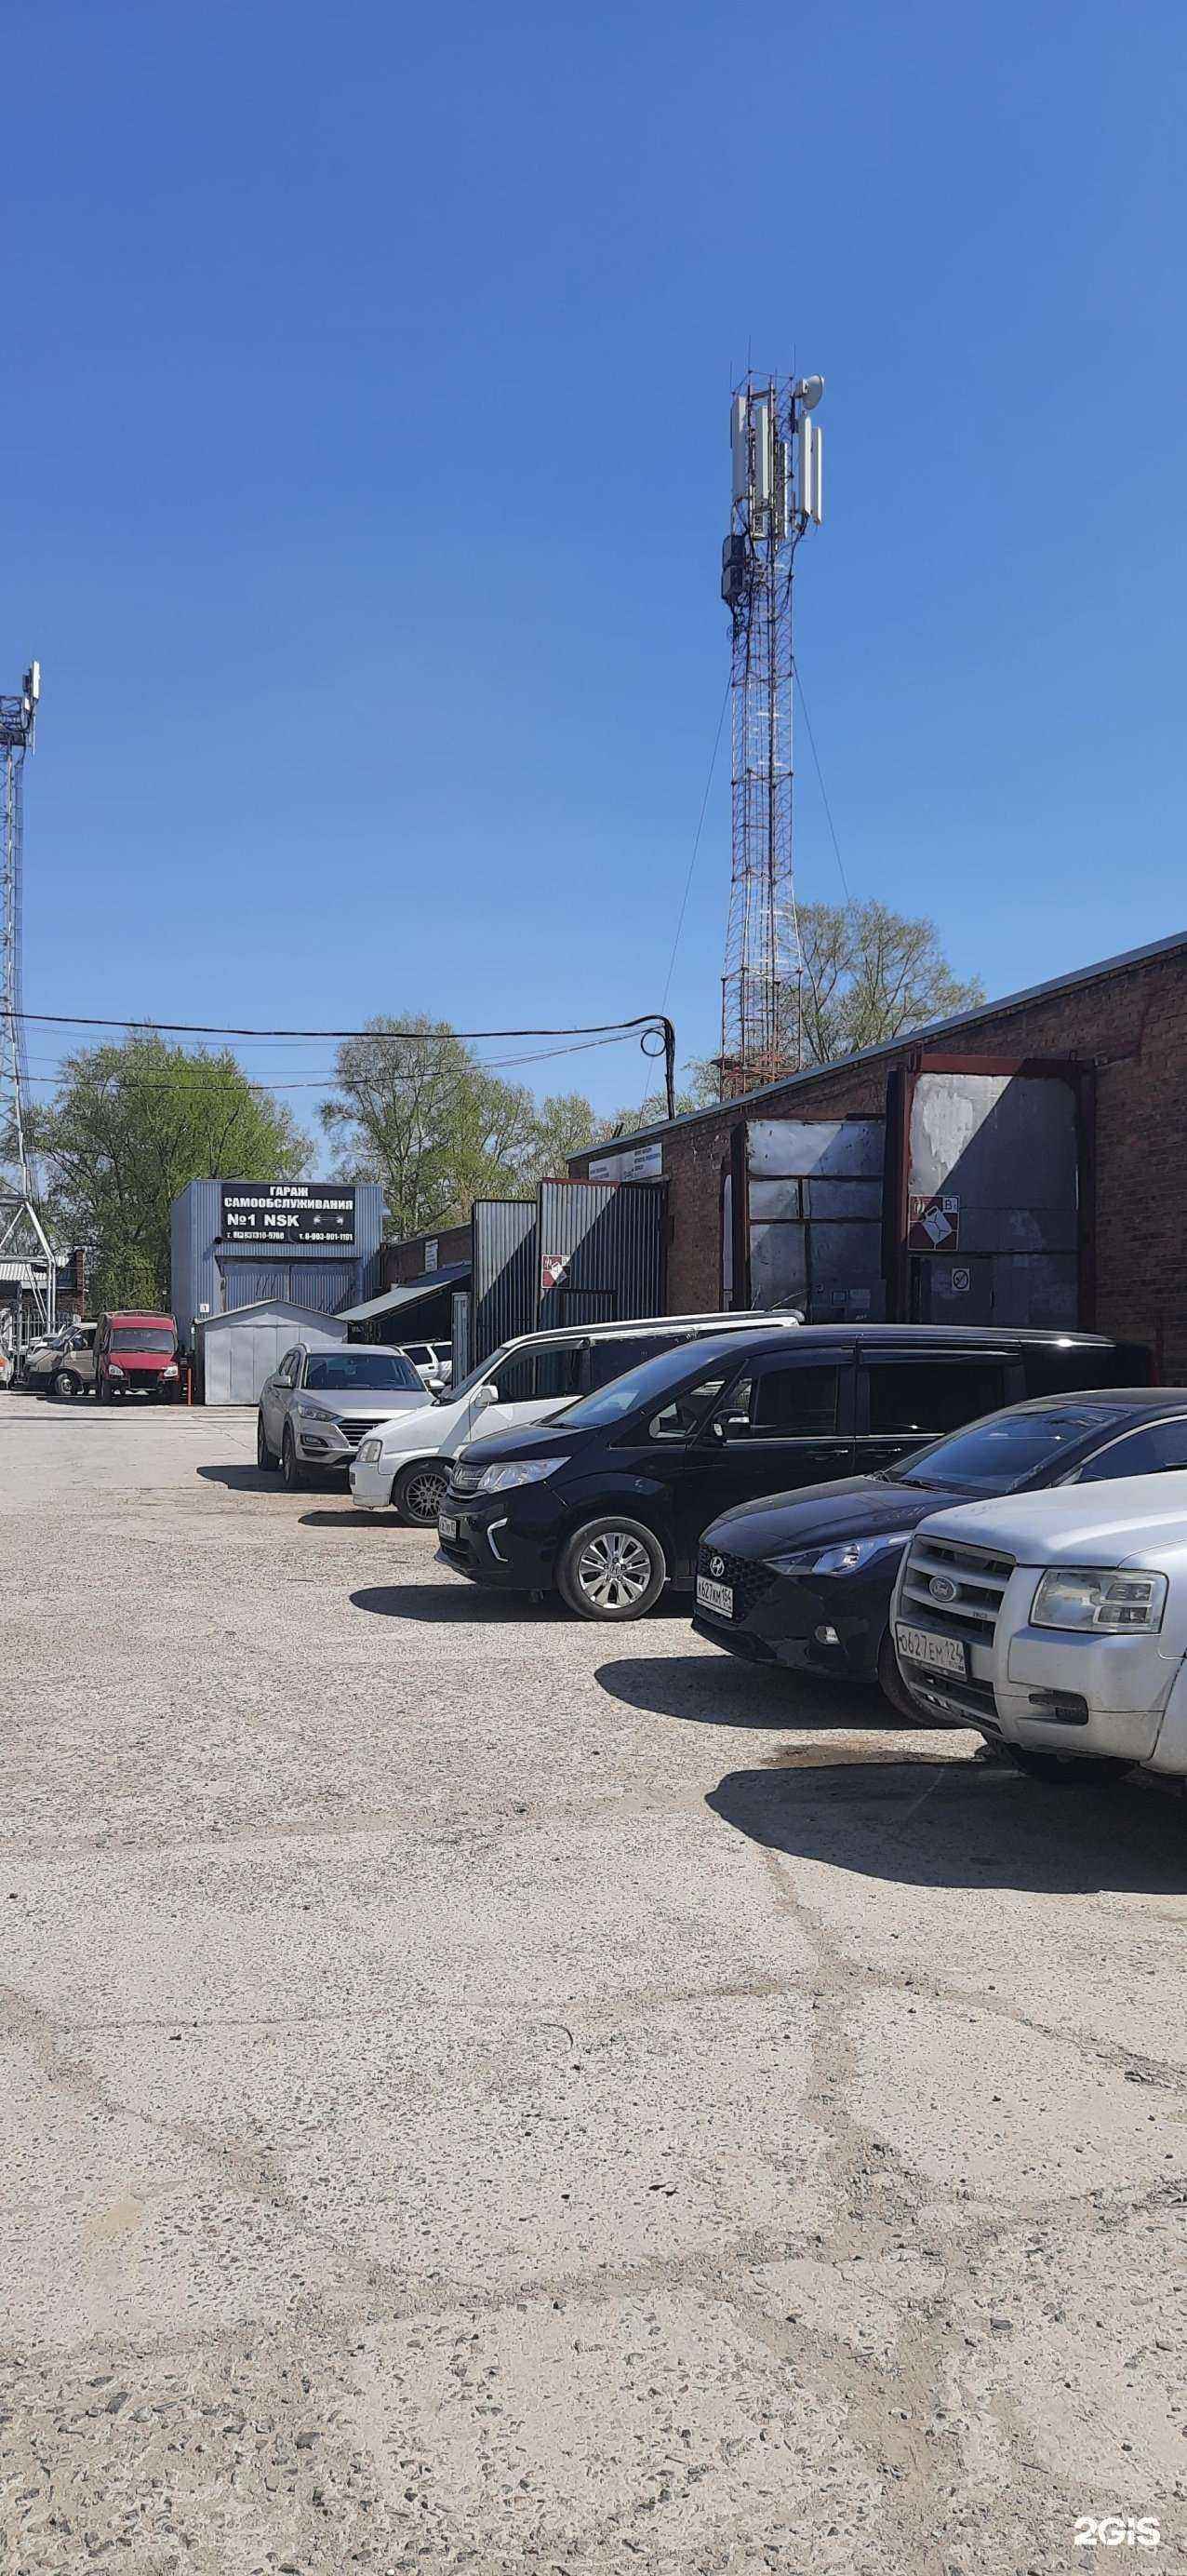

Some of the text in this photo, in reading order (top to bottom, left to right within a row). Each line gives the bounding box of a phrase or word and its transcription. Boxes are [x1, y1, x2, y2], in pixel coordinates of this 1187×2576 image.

[270, 1187, 309, 1197] ГАРАЖ
[224, 1198, 353, 1210] САМООБСЛУЖИВАНИЯ
[227, 1214, 300, 1227] №1 NSK
